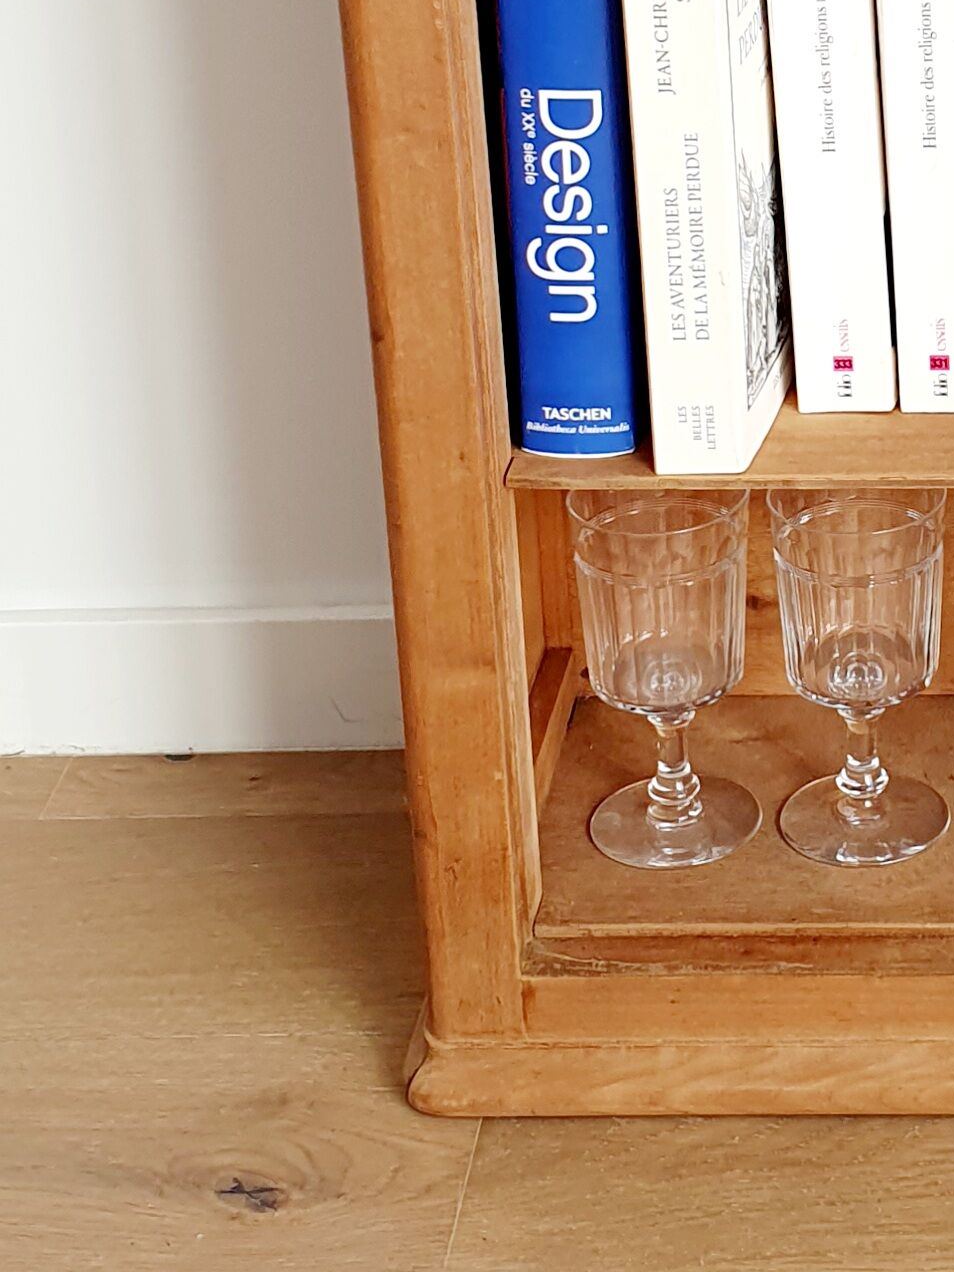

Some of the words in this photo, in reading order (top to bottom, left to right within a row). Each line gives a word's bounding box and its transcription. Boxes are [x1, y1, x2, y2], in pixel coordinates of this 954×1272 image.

[815, 6, 834, 66] religions
[917, 2, 938, 62] religions
[519, 88, 535, 108] du
[818, 70, 833, 94] des
[920, 66, 935, 90] des
[820, 98, 836, 153] Histoire
[921, 94, 937, 149] Histoire
[522, 142, 540, 186] siècle
[684, 132, 703, 202] PERDUE
[526, 89, 609, 323] Design
[663, 187, 686, 309] AVENTURIERS
[688, 205, 707, 290] MÉMOIRE
[693, 293, 709, 315] LA
[671, 313, 687, 341] LES
[695, 319, 710, 341] DE
[526, 421, 577, 434] Bibliotheca
[578, 422, 631, 434] Universalis
[541, 407, 612, 421] TASCHEN
[677, 406, 688, 423] LES
[691, 405, 703, 441] BELLES
[705, 405, 717, 450] LETTRES
